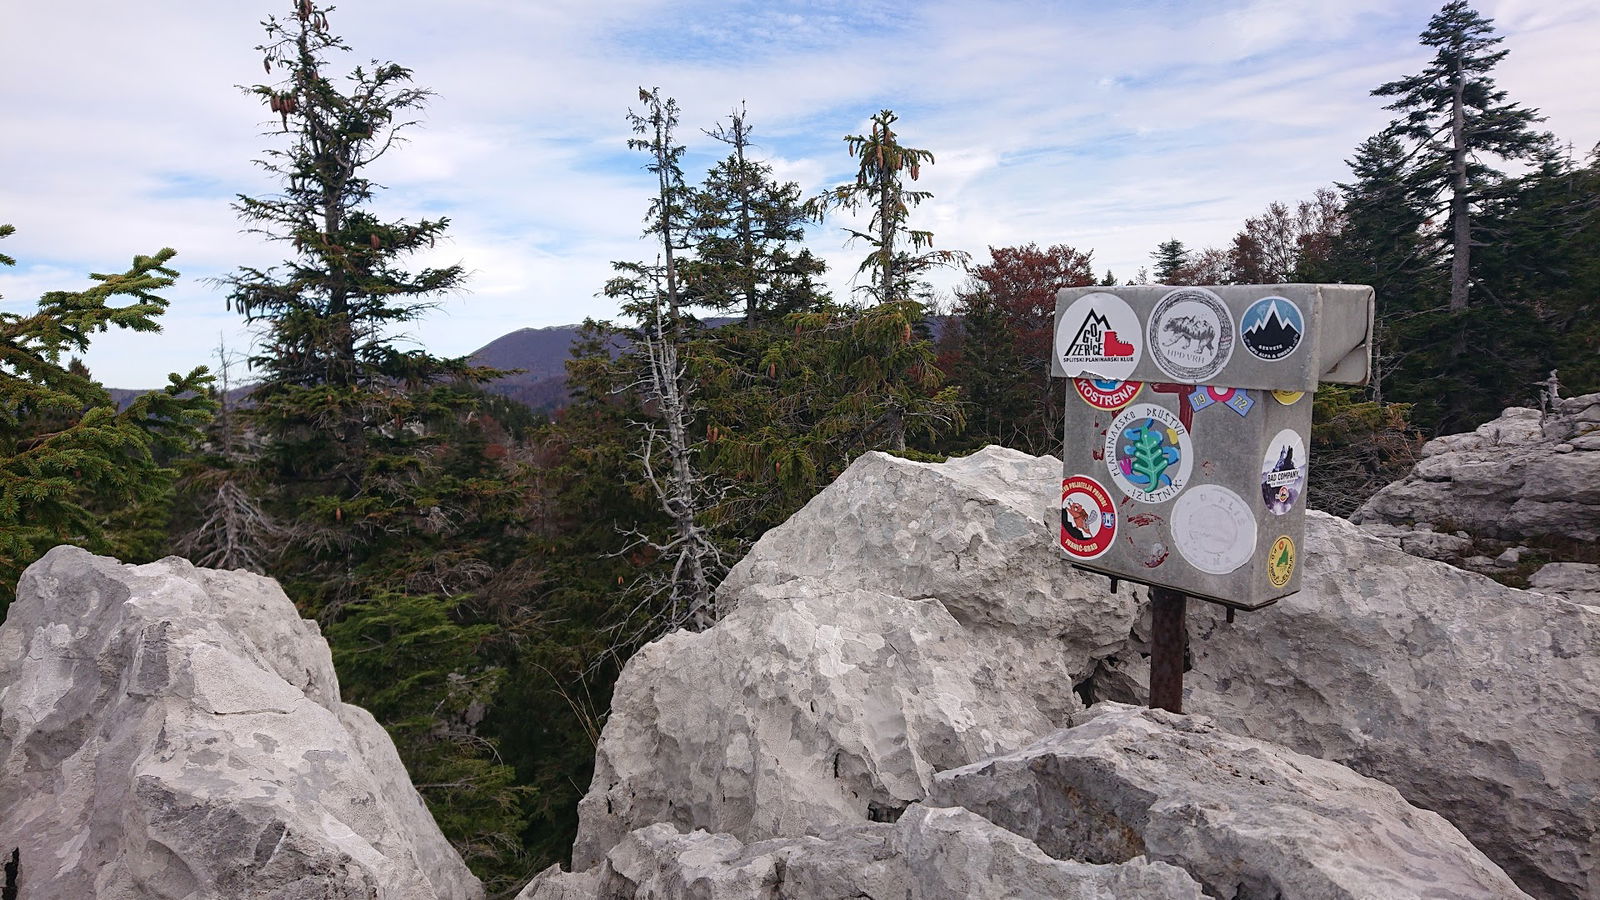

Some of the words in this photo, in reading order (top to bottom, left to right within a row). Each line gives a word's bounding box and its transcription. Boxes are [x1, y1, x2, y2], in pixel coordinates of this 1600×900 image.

[1078, 380, 1136, 406] KOSTRENA
[1194, 393, 1206, 407] 19
[1234, 395, 1248, 411] 72
[1267, 473, 1277, 482] BAD
[1277, 470, 1299, 481] COMPANY
